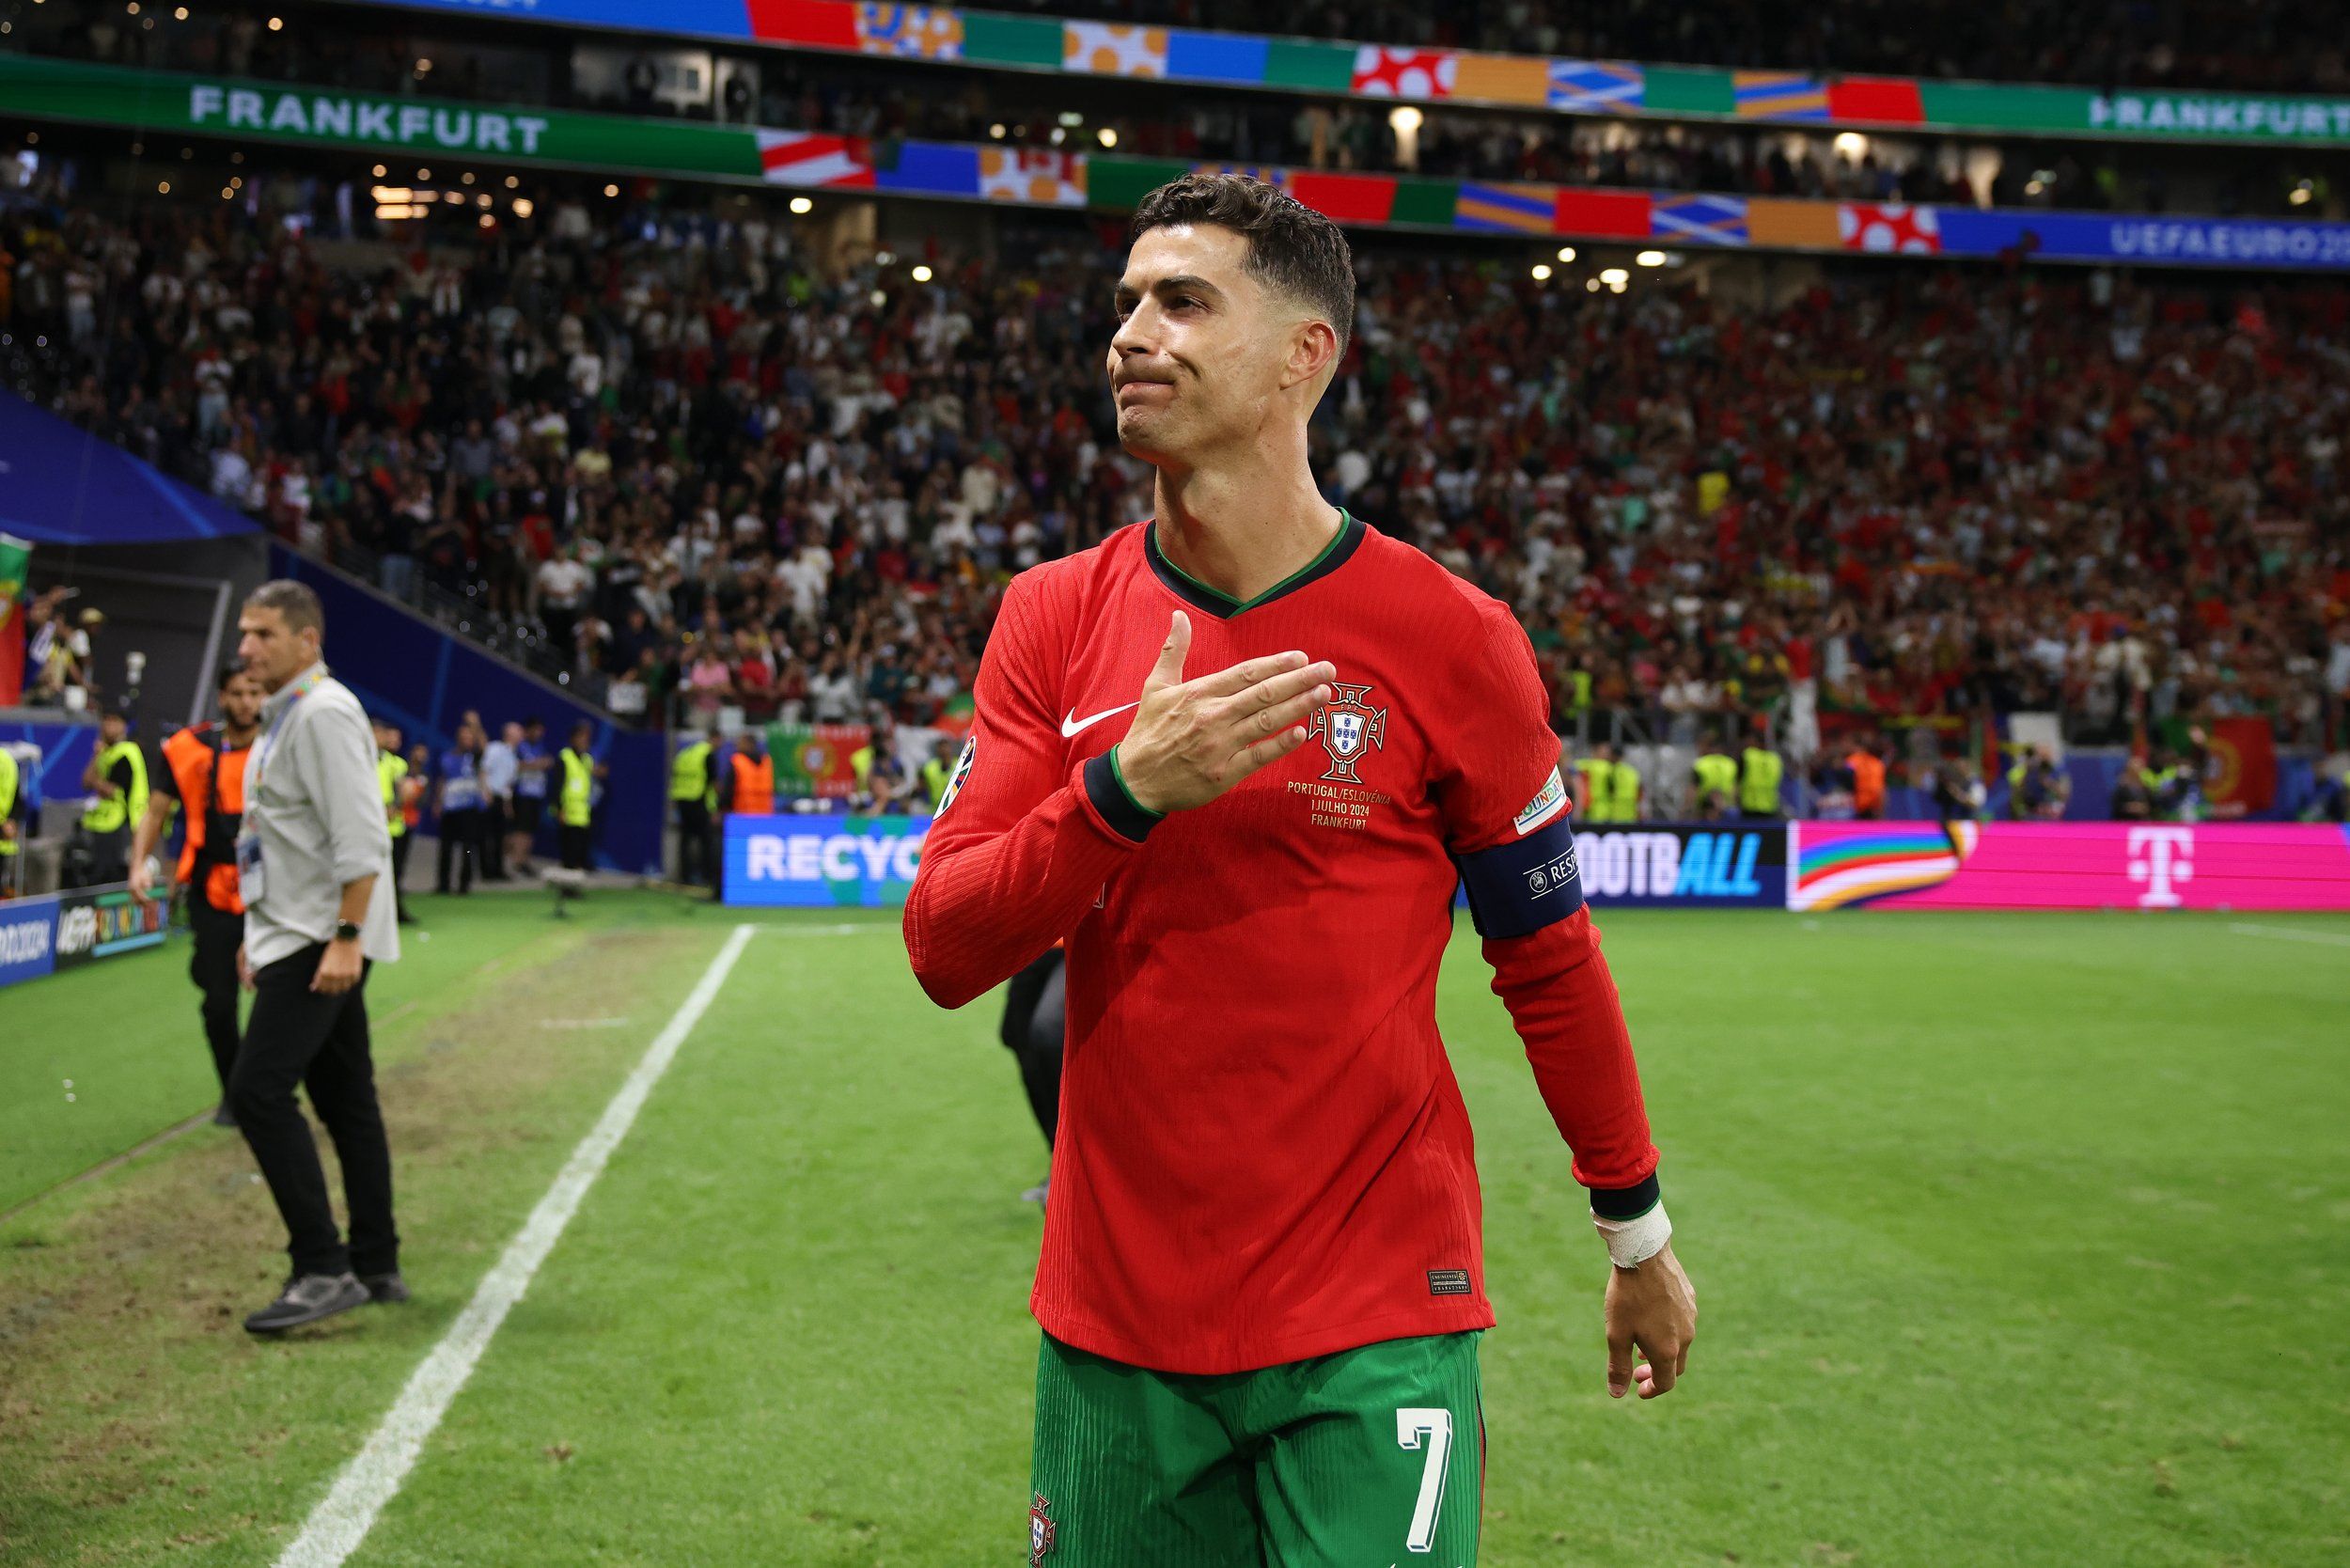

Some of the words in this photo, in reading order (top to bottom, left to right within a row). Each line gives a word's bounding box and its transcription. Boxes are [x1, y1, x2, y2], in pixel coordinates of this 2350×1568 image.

[191, 85, 548, 154] FRANKFURT
[1311, 813, 1367, 830] FRANKFURT
[1350, 804, 1370, 816] 2024
[2127, 826, 2194, 908] T
[1396, 1408, 1453, 1553] 7
